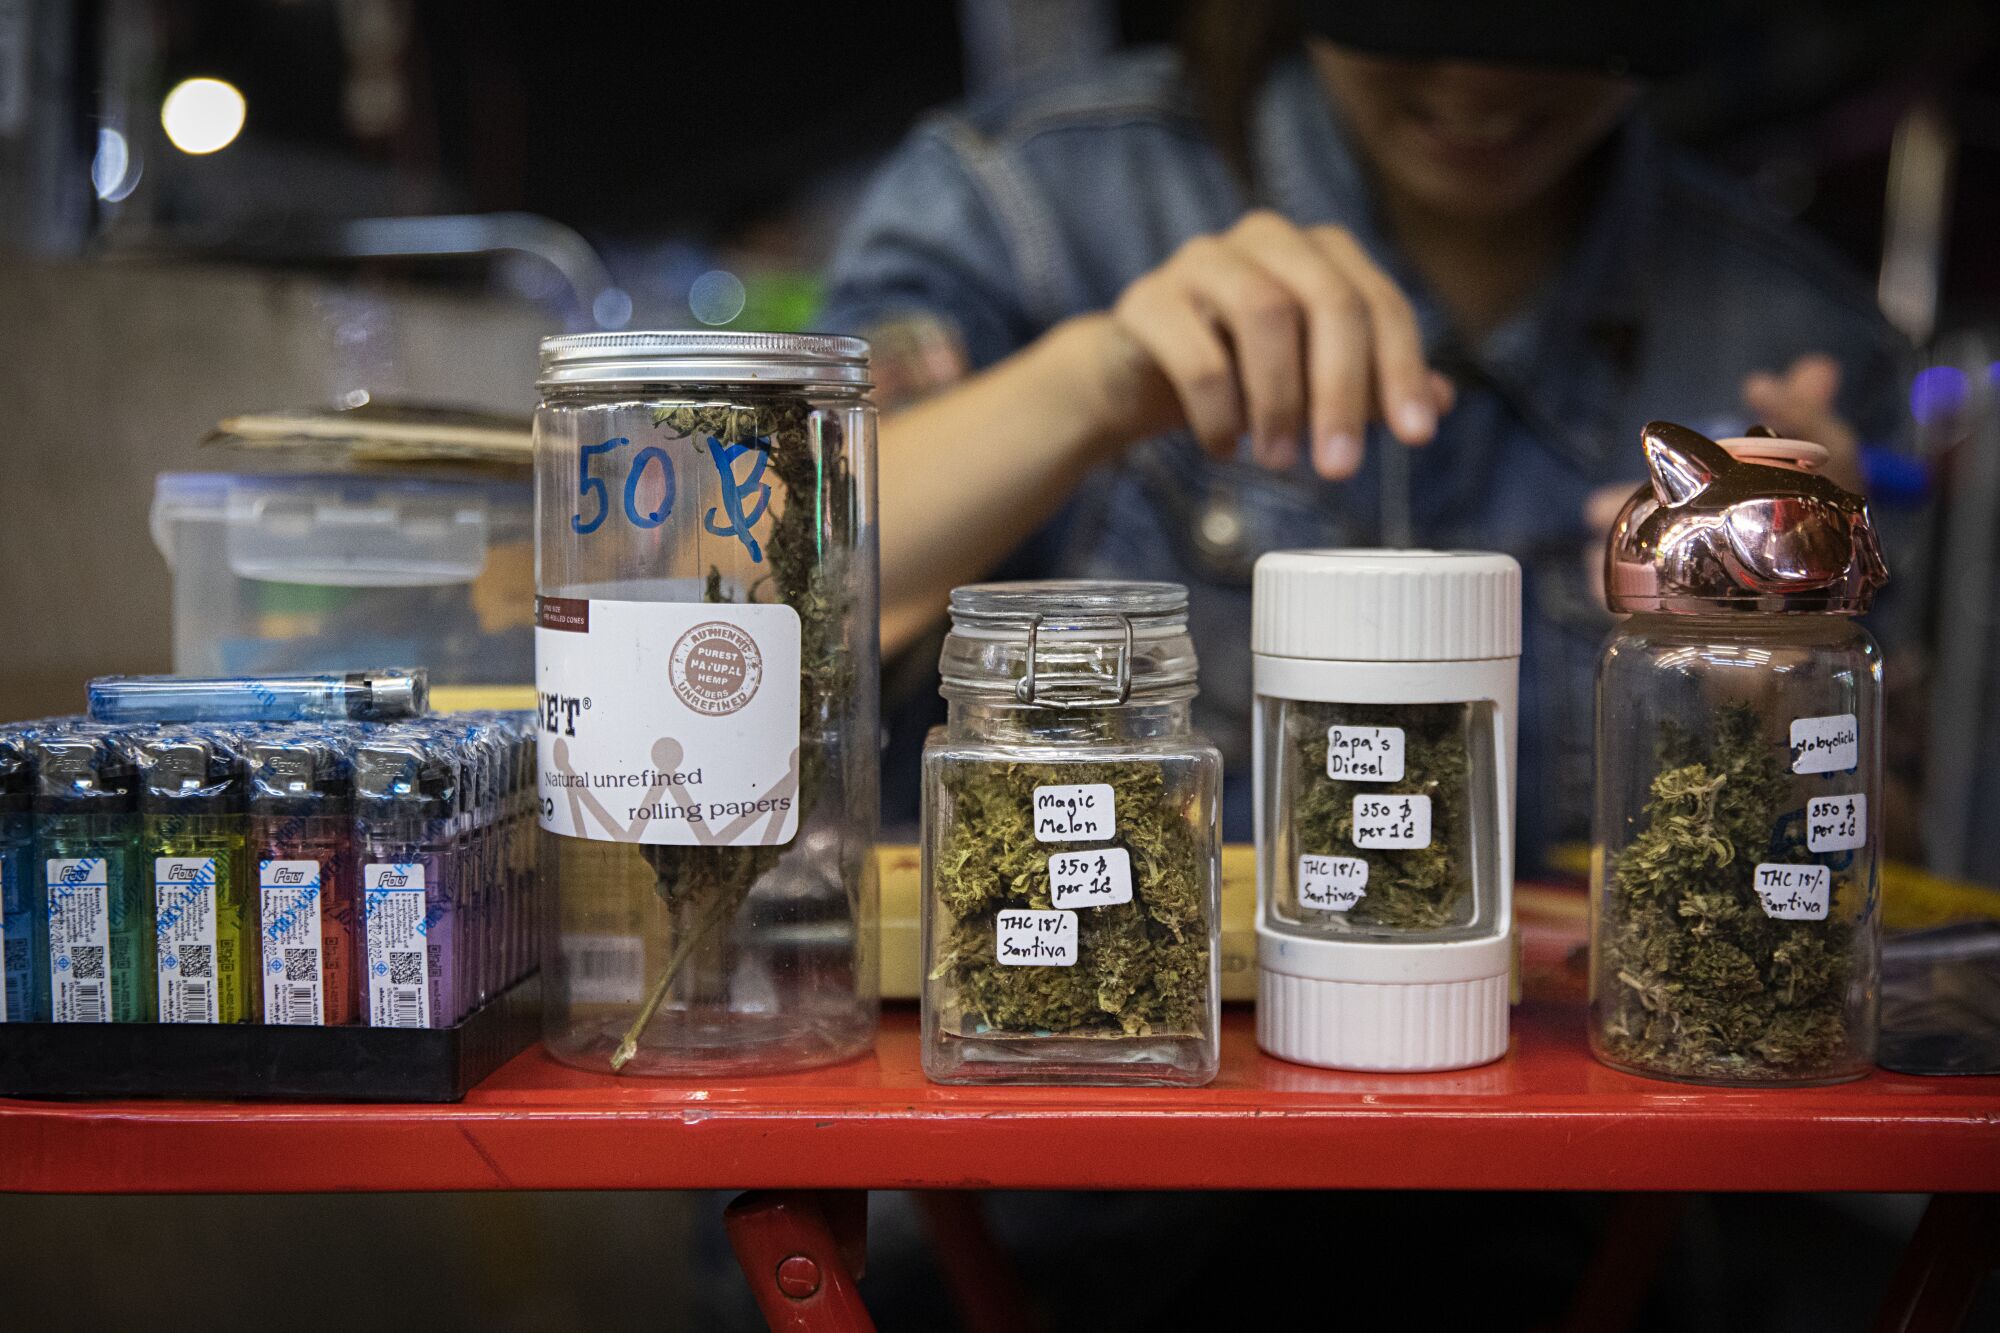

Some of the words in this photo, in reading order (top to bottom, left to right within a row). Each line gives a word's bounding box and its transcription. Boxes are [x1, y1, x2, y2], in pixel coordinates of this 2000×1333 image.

[571, 437, 676, 535] 50
[566, 616, 585, 625] CONES
[690, 628, 752, 653] AUTHENTIC
[698, 647, 738, 661] PUREST
[697, 673, 728, 685] HEMP
[678, 681, 748, 711] UNREFINED
[694, 684, 729, 699] FIBERS
[1333, 729, 1391, 758] Papa's
[1332, 755, 1383, 776] Diesel
[545, 772, 589, 788] Natural
[593, 769, 703, 788] unrefined
[629, 801, 703, 823] rolling
[709, 796, 791, 820] papers
[1038, 789, 1095, 816] Magic
[1360, 802, 1390, 818] 350
[1812, 803, 1840, 818] 350
[1039, 815, 1097, 834] Melon
[1812, 824, 1834, 842] per
[1359, 826, 1385, 843] per
[1057, 858, 1089, 876] 350
[1303, 861, 1329, 875] THC
[1760, 870, 1793, 887] THC
[1056, 882, 1083, 900] per
[1000, 916, 1033, 930] THC
[1002, 936, 1066, 957] Santiva
